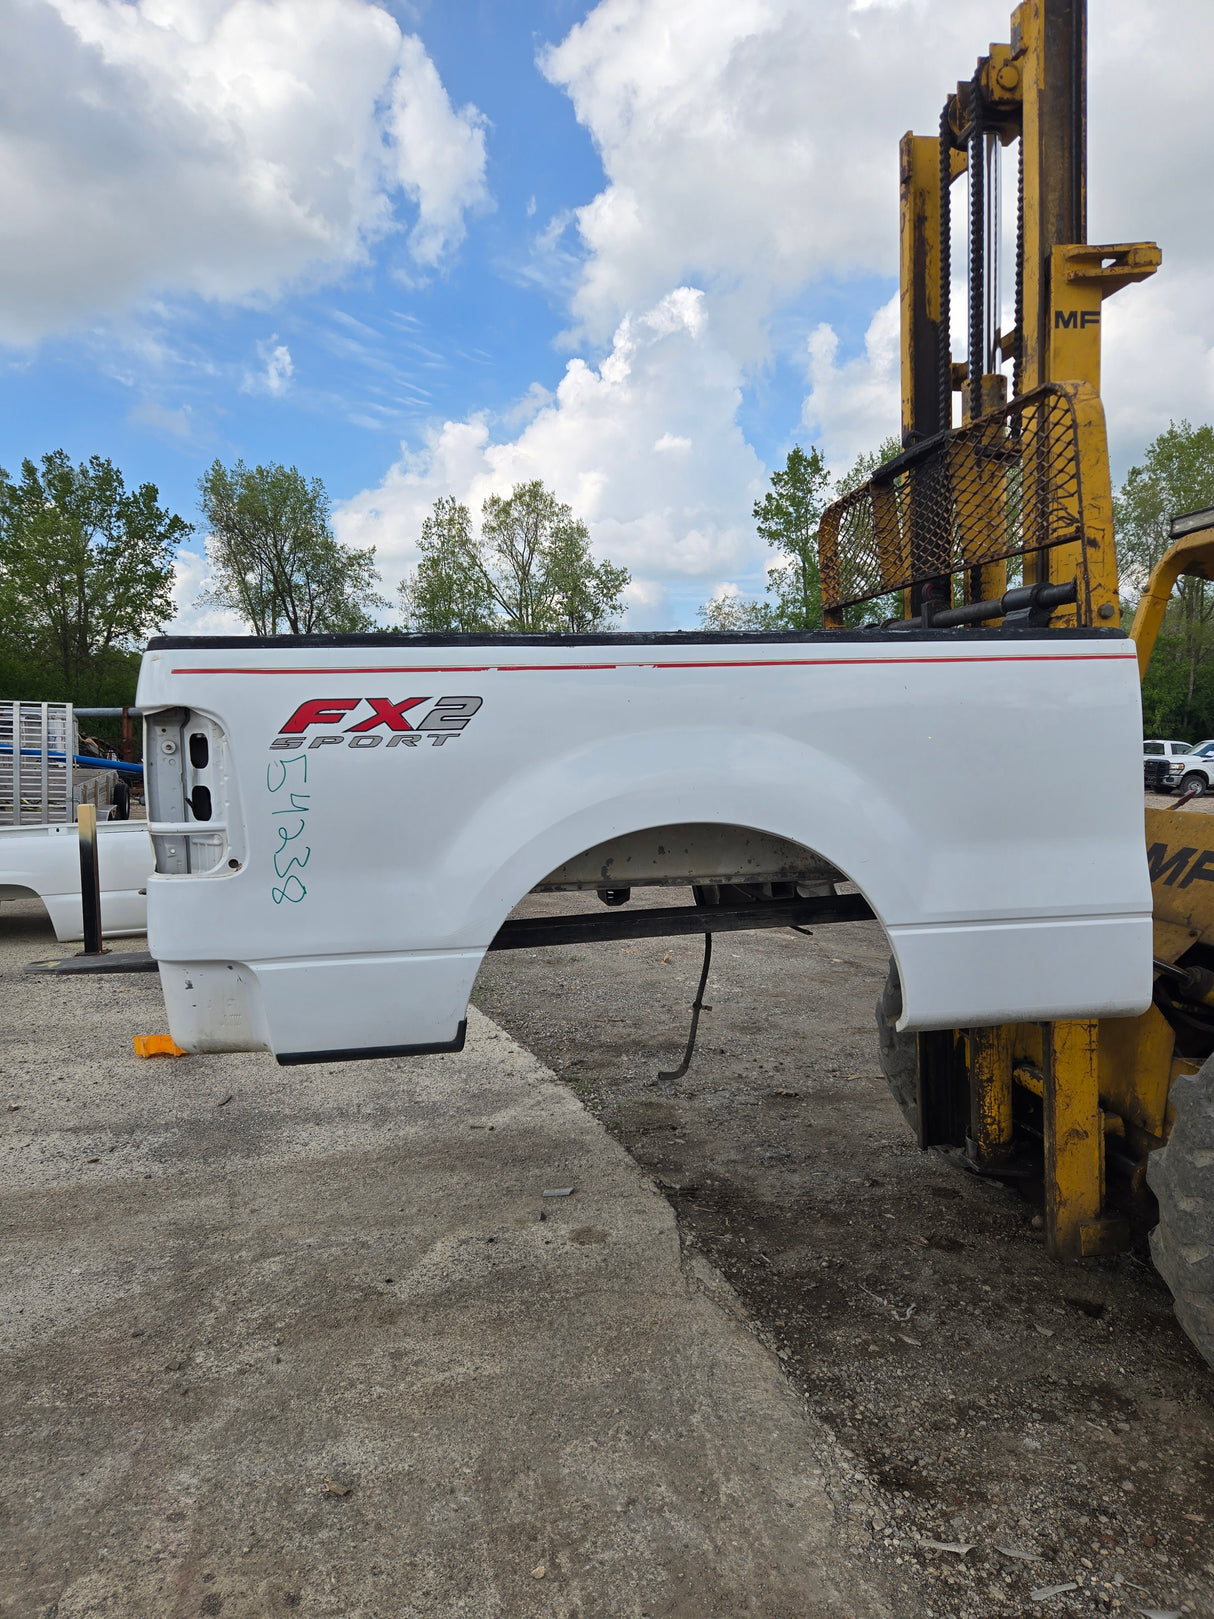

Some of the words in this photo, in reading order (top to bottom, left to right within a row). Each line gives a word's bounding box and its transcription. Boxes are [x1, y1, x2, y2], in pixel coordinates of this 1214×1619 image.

[1055, 310, 1101, 329] MF
[278, 696, 484, 733] FX2
[269, 734, 460, 750] SPORT
[267, 754, 311, 904] 54238
